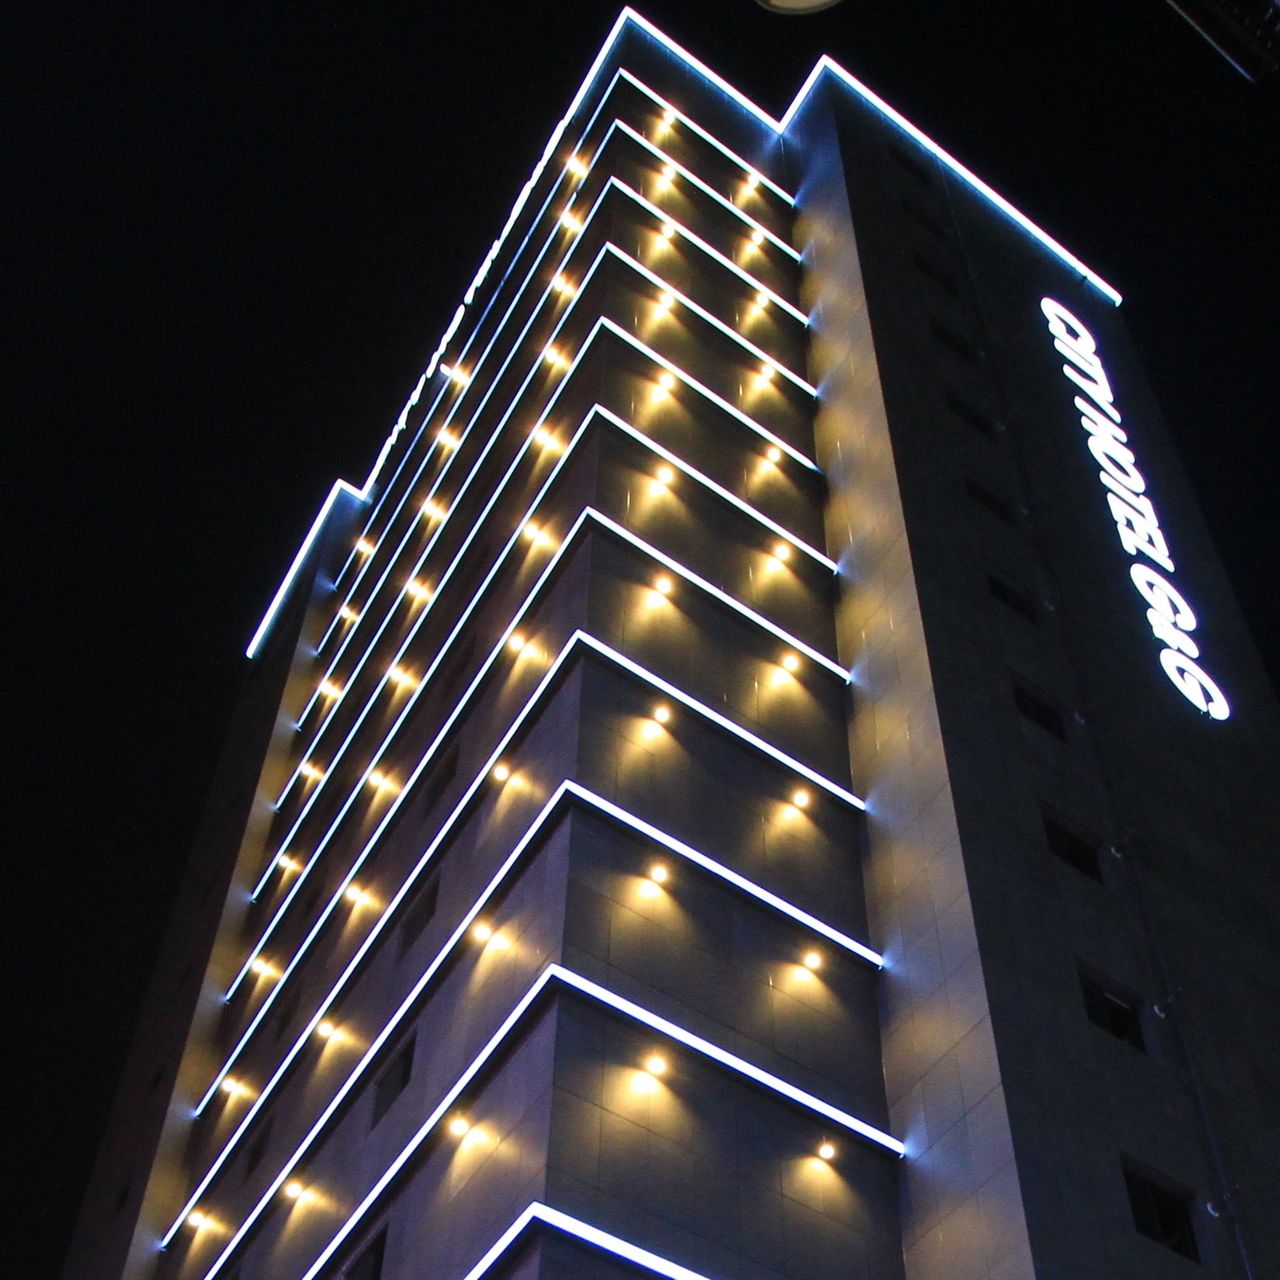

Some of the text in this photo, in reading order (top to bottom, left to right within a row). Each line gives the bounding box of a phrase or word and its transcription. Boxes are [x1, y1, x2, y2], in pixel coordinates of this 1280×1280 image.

[1040, 297, 1230, 720] CITY HOTEL G&G
